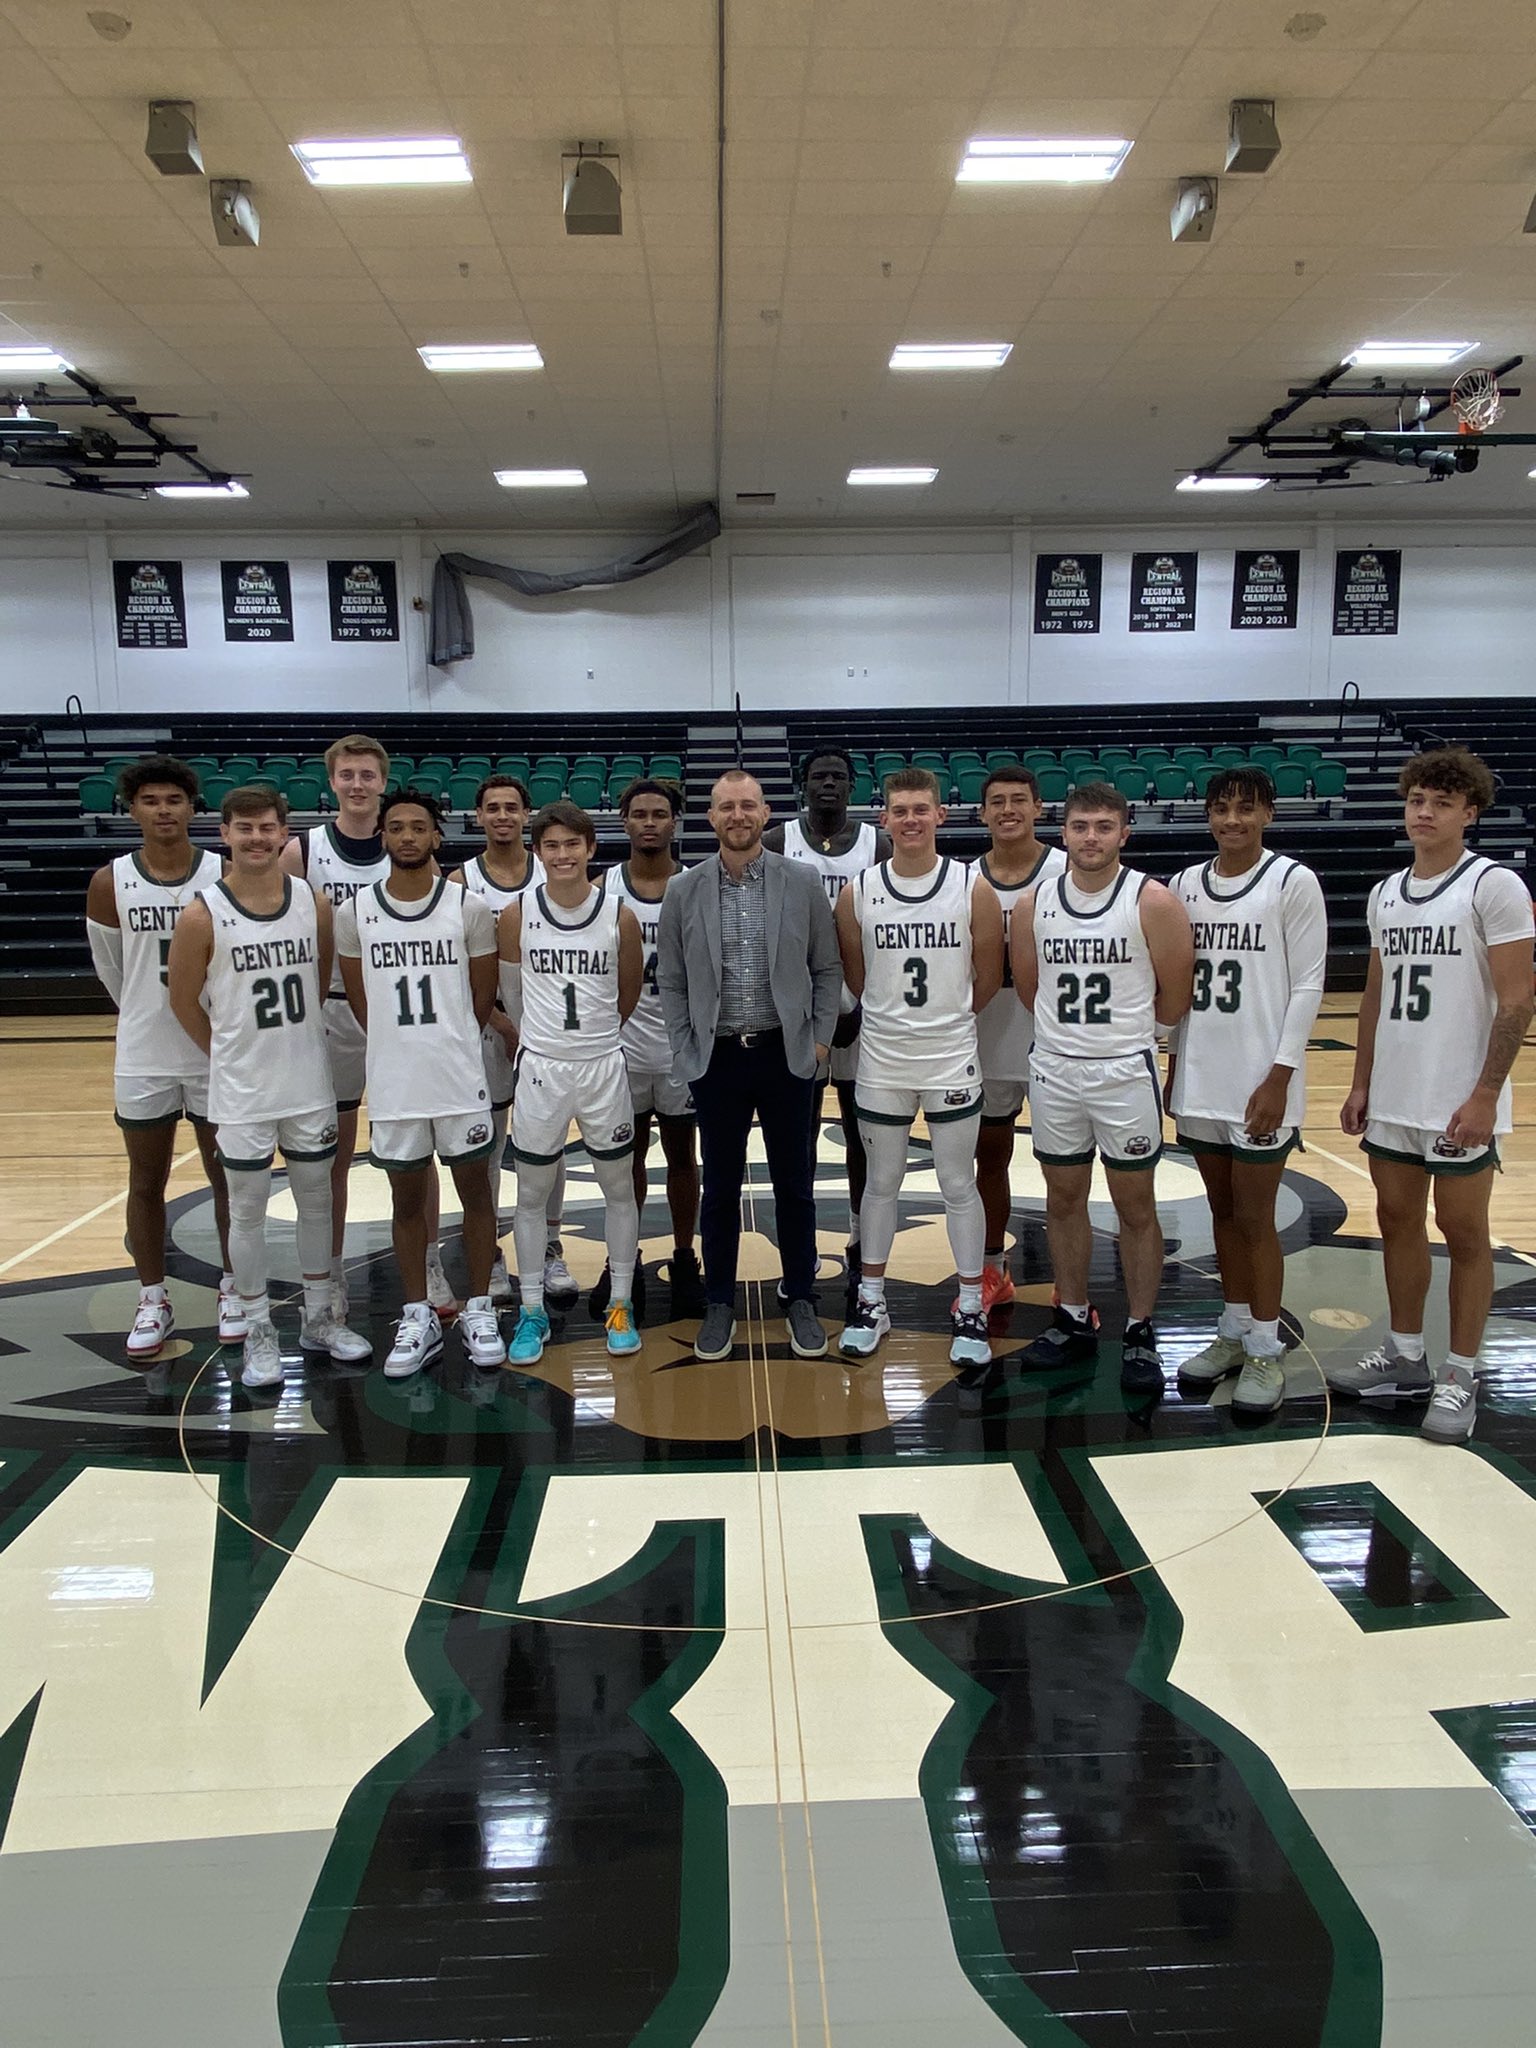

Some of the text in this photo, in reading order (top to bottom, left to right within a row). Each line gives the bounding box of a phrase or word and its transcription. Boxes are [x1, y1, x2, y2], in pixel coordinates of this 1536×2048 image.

[1143, 588, 1184, 596] REGION IX
[1245, 585, 1286, 593] REGION IX
[1346, 584, 1388, 593] REGION IX
[1047, 589, 1088, 598] REGION IX
[1242, 594, 1288, 602] CHAMPIONS
[1344, 593, 1389, 602] CHAMPIONS
[128, 596, 172, 604] REGION IX
[235, 597, 279, 605] REGION IX
[342, 596, 385, 605] REGION IX
[1045, 598, 1090, 607] CHAMPIONS
[1140, 596, 1186, 605] CHAMPIONS
[127, 605, 174, 613] CHAMPIONS
[234, 606, 281, 614] CHAMPIONS
[340, 605, 387, 614] CHAMPIONS
[1041, 620, 1094, 629] 1972 1975
[1240, 616, 1288, 625] 2020 2021
[247, 628, 271, 637] 2020
[338, 628, 393, 637] 1972 1974
[128, 906, 186, 932] CENT
[875, 922, 961, 949] CENTRAL
[1190, 923, 1266, 952] ENTRAL
[1382, 926, 1462, 957] CENTRAL
[231, 937, 314, 973] CENTRAL
[371, 940, 458, 969] CENTRAL
[1043, 938, 1133, 964] CENTRAL
[529, 949, 609, 975] CENTRAL
[903, 957, 928, 1007] 3
[1192, 958, 1242, 1013] 33
[1390, 964, 1432, 1022] 15
[252, 973, 306, 1030] 20
[395, 974, 438, 1026] 11
[1057, 972, 1112, 1024] 22
[562, 982, 580, 1030] 1
